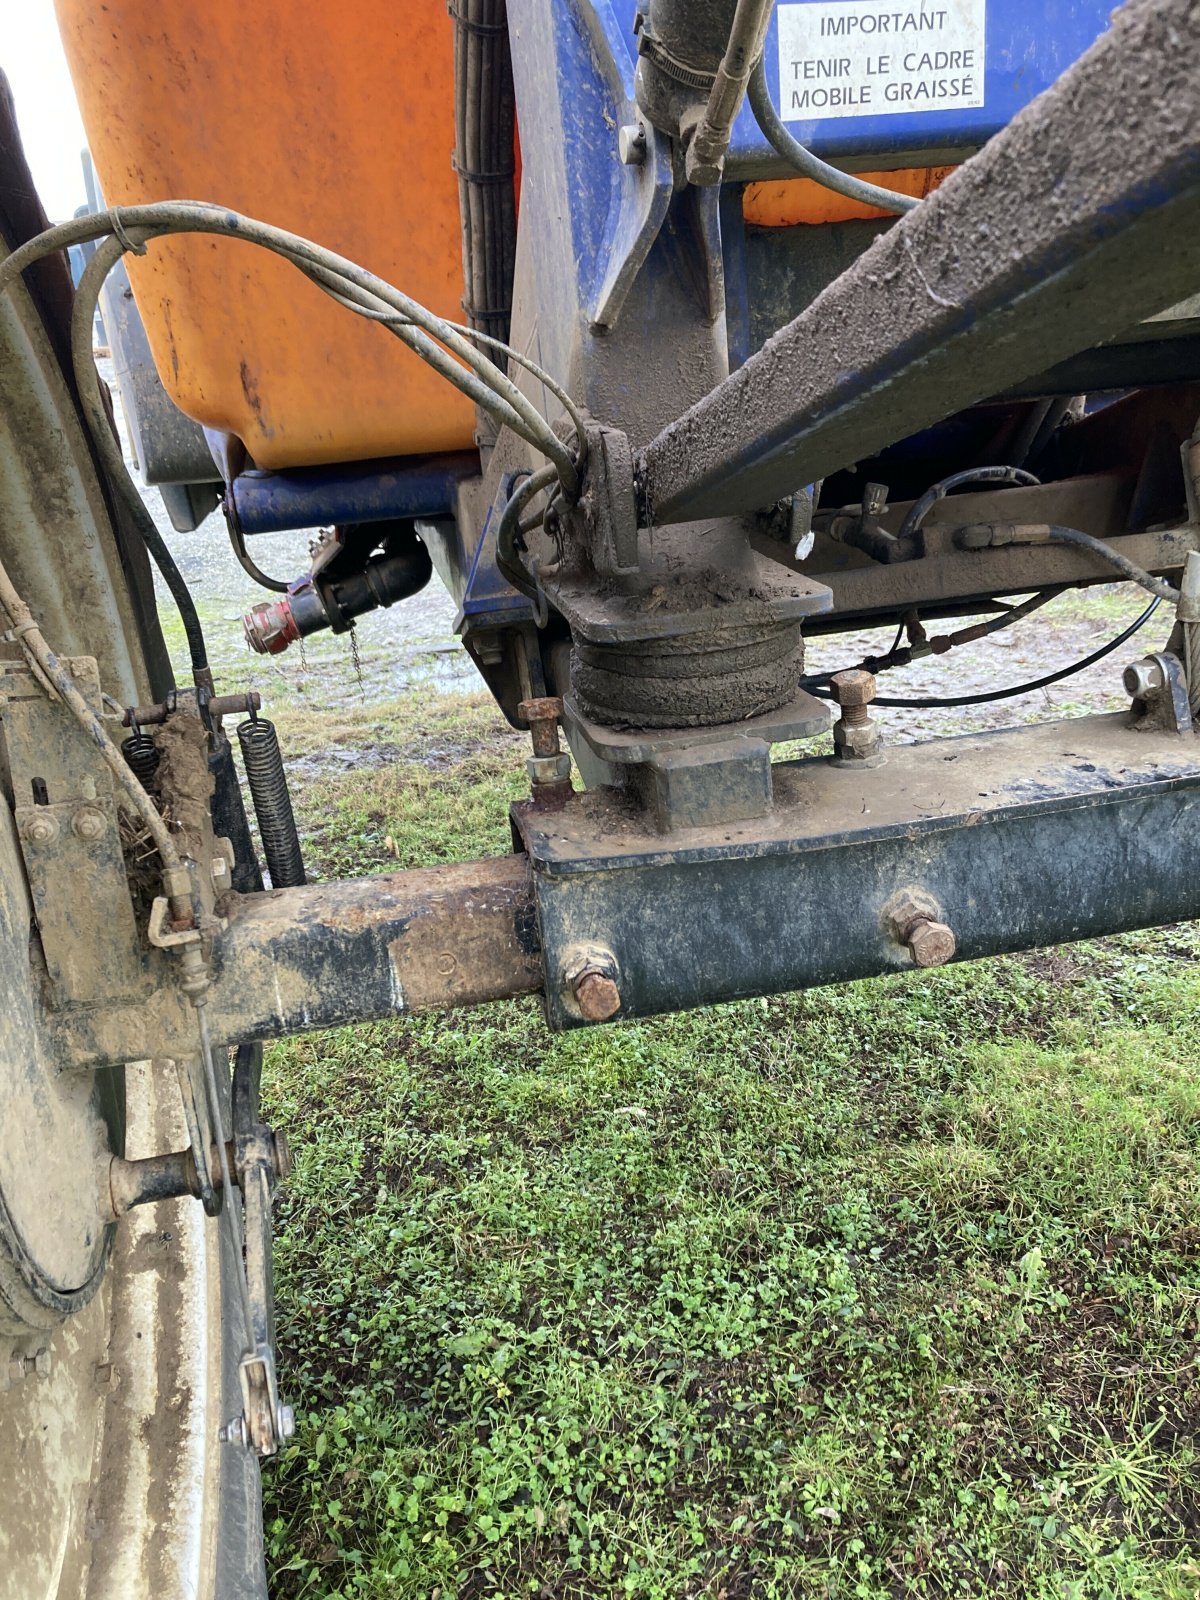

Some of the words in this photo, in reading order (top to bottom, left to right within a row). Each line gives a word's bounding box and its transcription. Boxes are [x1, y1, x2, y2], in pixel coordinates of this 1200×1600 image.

[820, 11, 947, 36] IMPORTANT
[791, 58, 851, 79] TENIR
[866, 55, 890, 75] LE
[903, 49, 975, 72] CADRE
[791, 85, 872, 109] MOBILE
[884, 74, 973, 101] GRAISSÉ
